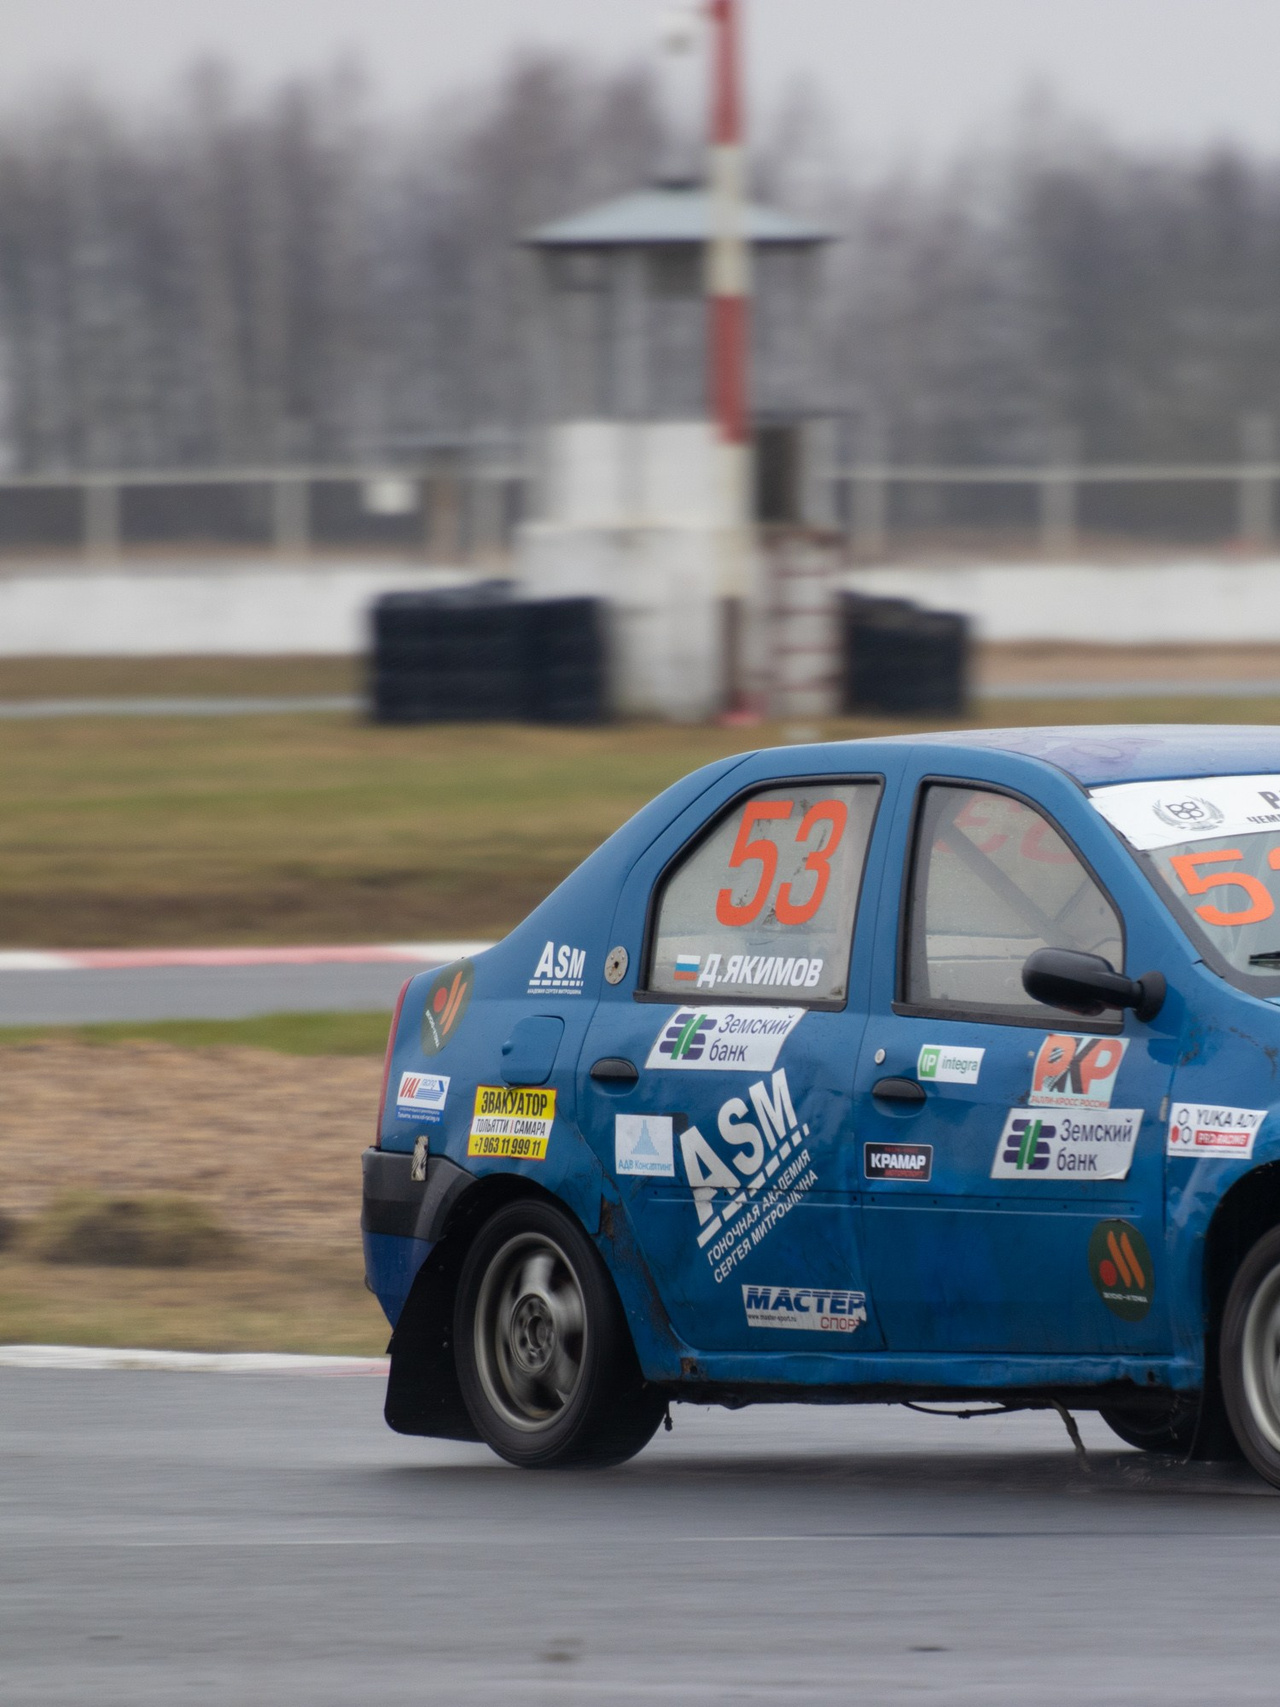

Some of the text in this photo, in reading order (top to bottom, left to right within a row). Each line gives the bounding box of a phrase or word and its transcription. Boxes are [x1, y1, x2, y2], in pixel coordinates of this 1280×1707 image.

[715, 799, 848, 927] 53
[533, 941, 587, 979] ASM
[696, 953, 823, 988] Д.ЯКИМОВ
[718, 1013, 795, 1035] Земский
[709, 1038, 749, 1061] банк
[922, 1054, 937, 1072] IP
[942, 1056, 978, 1074] integra
[400, 1077, 421, 1098] VAL
[481, 1091, 548, 1116] ЭВАКУАТОР
[475, 1118, 546, 1136] ТОЛЬЯТТИ САМАРА
[1197, 1109, 1233, 1127] YUKA
[1060, 1118, 1133, 1143] Земский
[679, 1067, 798, 1226] ASM
[618, 1159, 634, 1171] АДВ
[870, 1153, 926, 1170] КРАМАР
[1057, 1147, 1098, 1171] банк
[706, 1149, 811, 1266] ГОНОЧНАЯ АКАДЕМИЯ
[713, 1237, 752, 1284] СЕРГЕЯ
[746, 1287, 865, 1315] МАСТЕР
